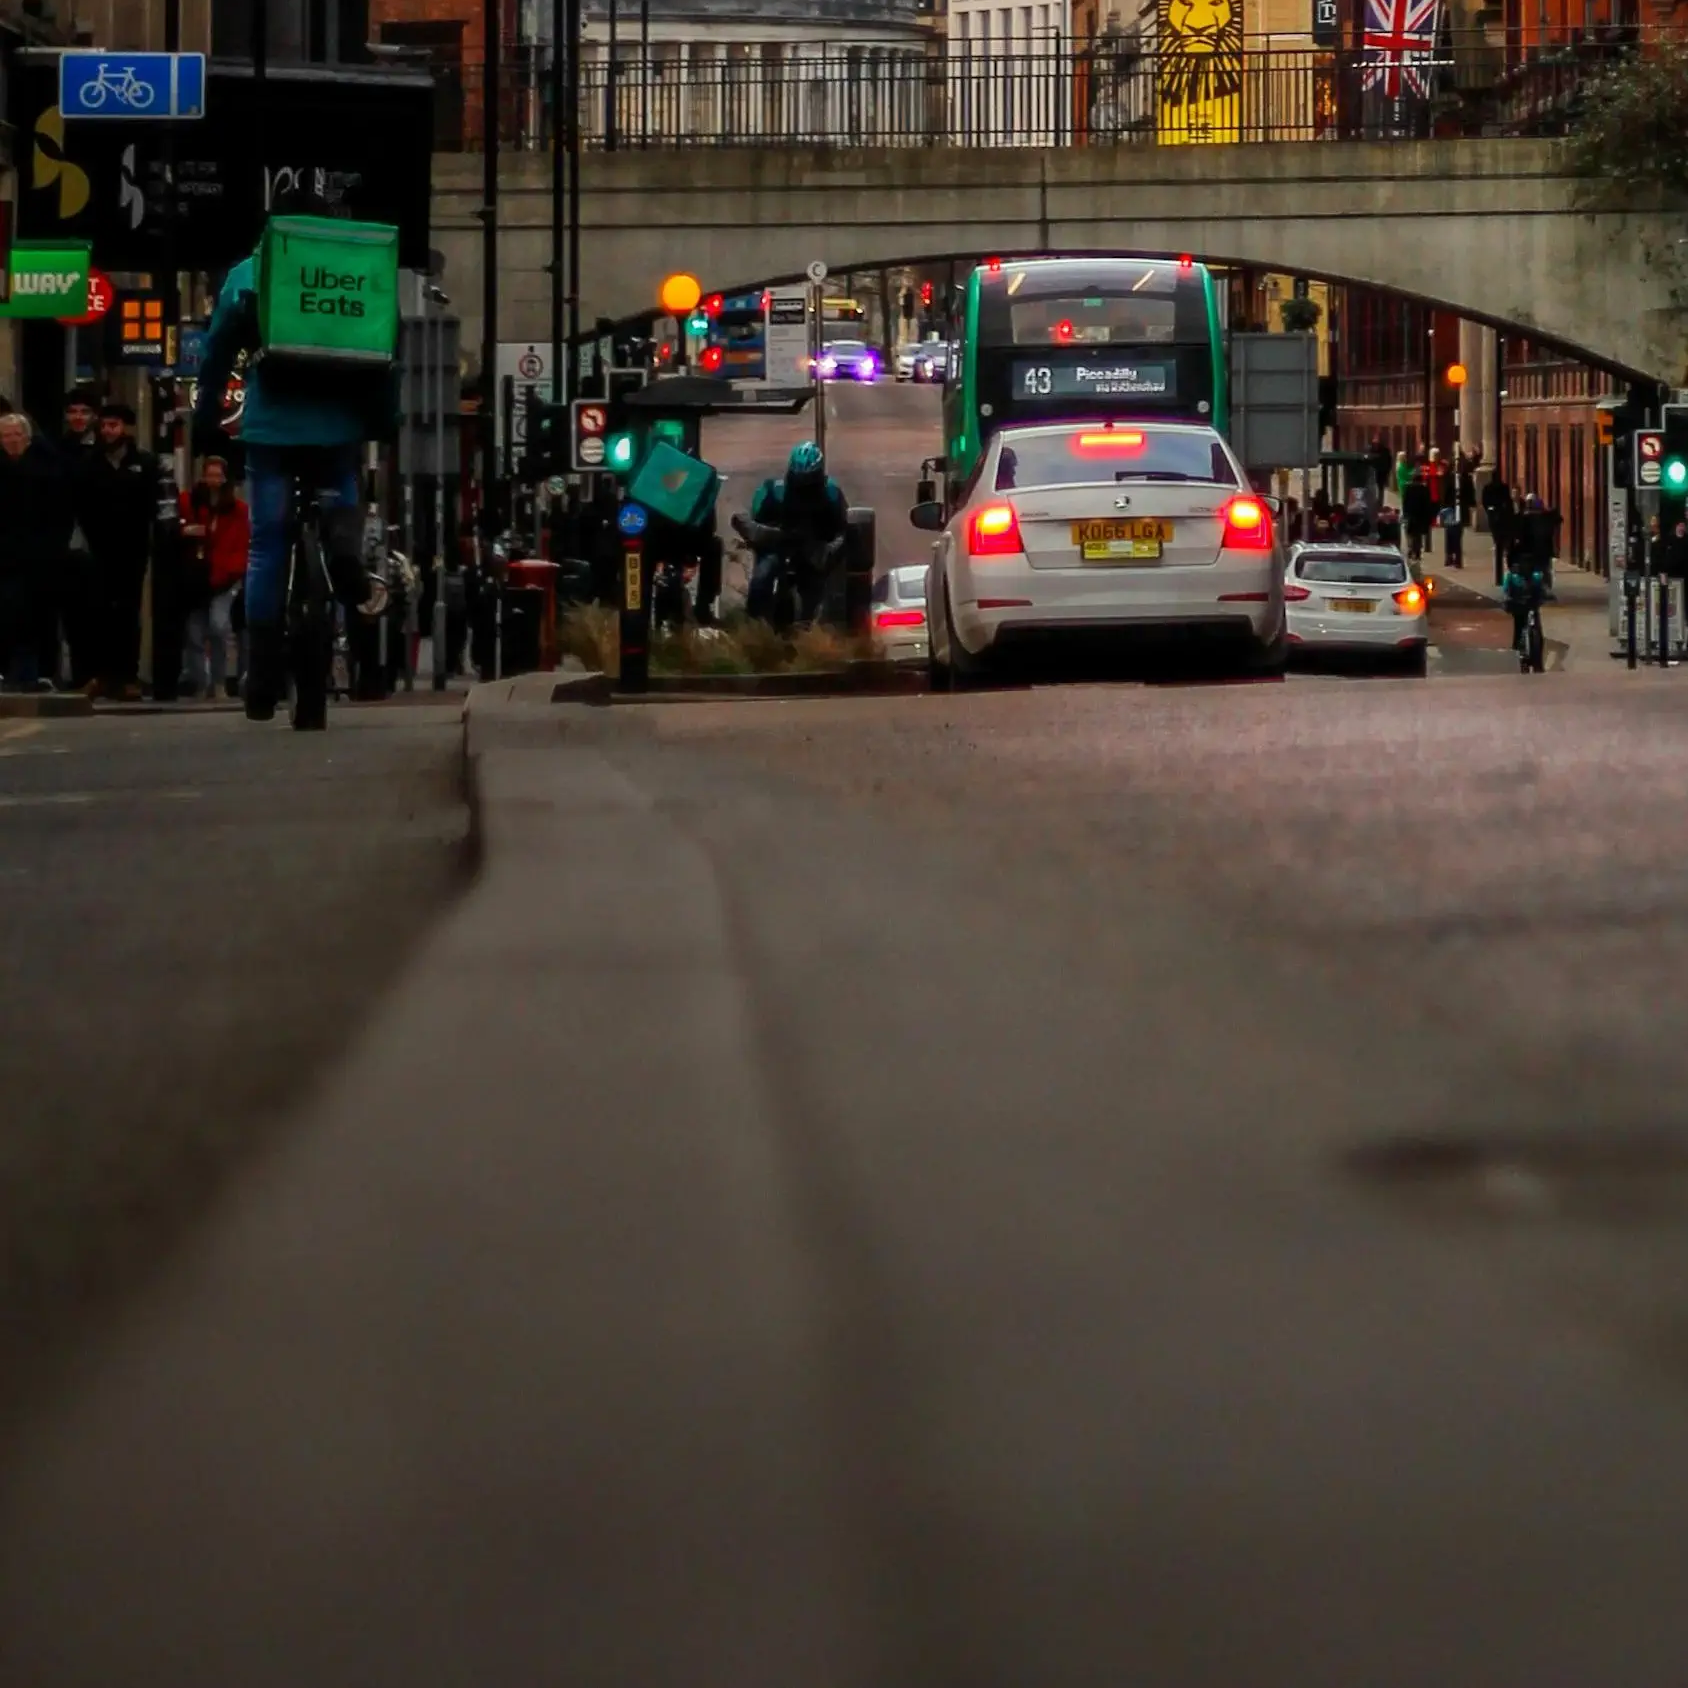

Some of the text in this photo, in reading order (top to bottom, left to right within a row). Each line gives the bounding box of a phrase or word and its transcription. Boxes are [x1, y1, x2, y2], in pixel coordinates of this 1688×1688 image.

[300, 265, 366, 292] Uber
[300, 292, 365, 318] Eats
[1024, 366, 1138, 394] 43 Piccadilly
